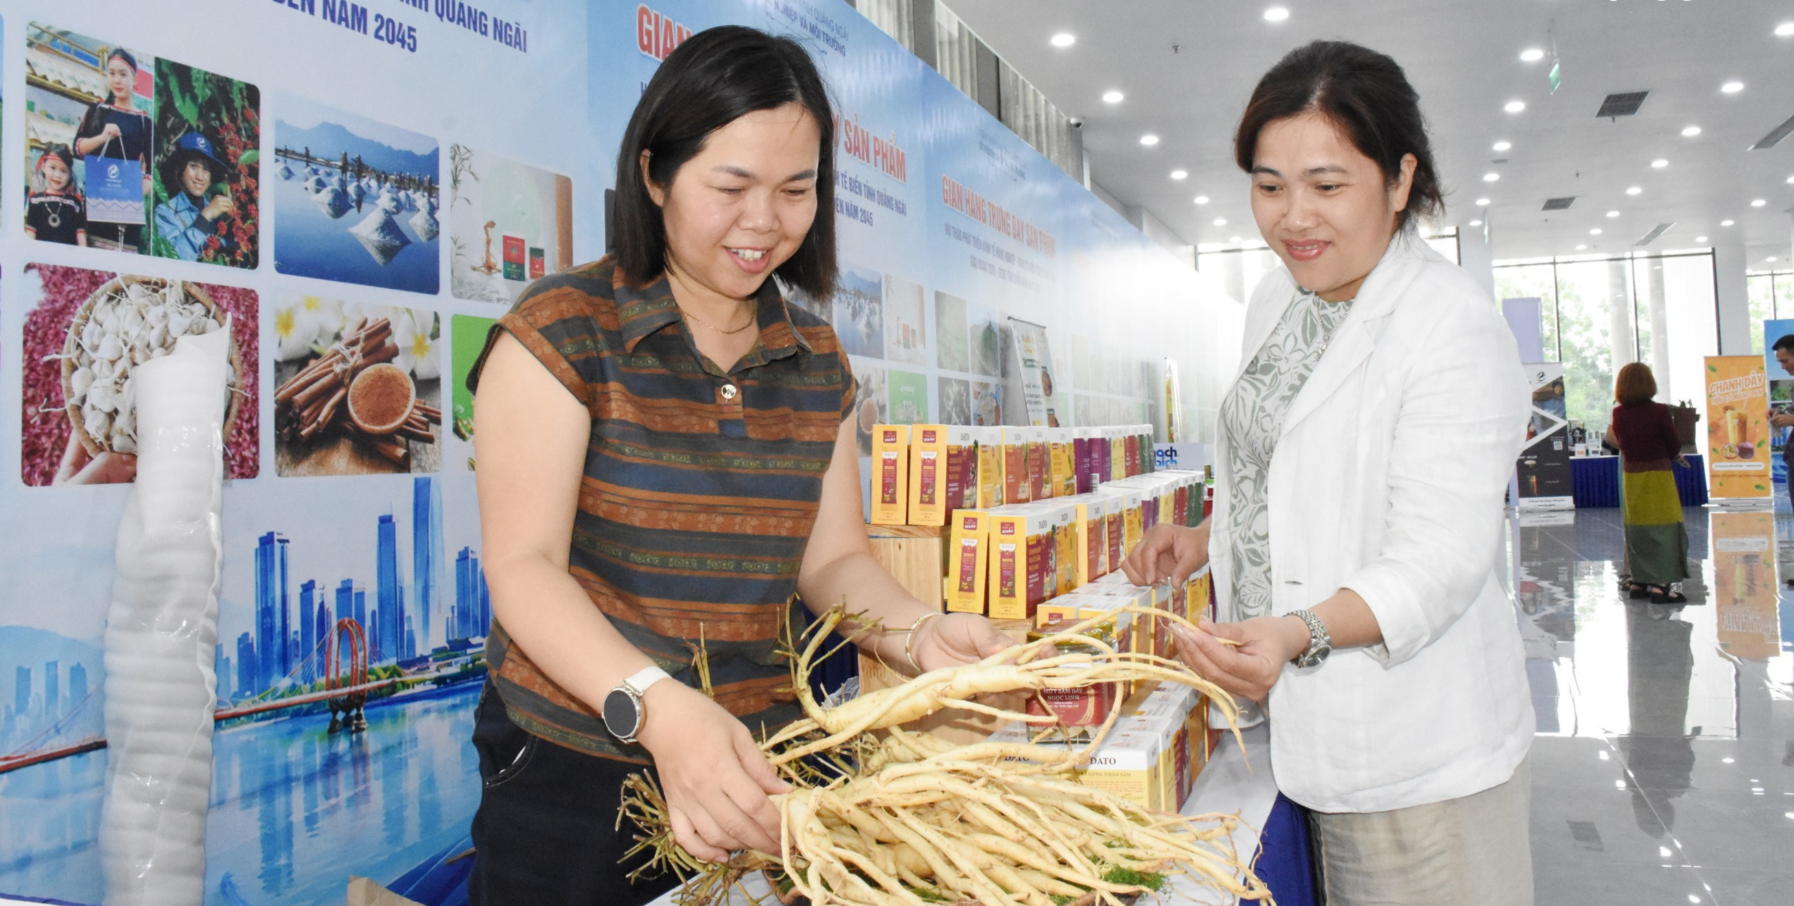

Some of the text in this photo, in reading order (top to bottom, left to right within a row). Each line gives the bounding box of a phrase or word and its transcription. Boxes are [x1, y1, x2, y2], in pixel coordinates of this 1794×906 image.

[374, 13, 417, 53] 2045
[493, 17, 527, 53] NGÃI
[844, 113, 870, 164] SẢN
[873, 132, 906, 182] PHẨM
[942, 175, 963, 212] GIAN
[1709, 377, 1742, 394] CHANH
[1154, 446, 1178, 457] ach
[1090, 757, 1117, 765] DATO
